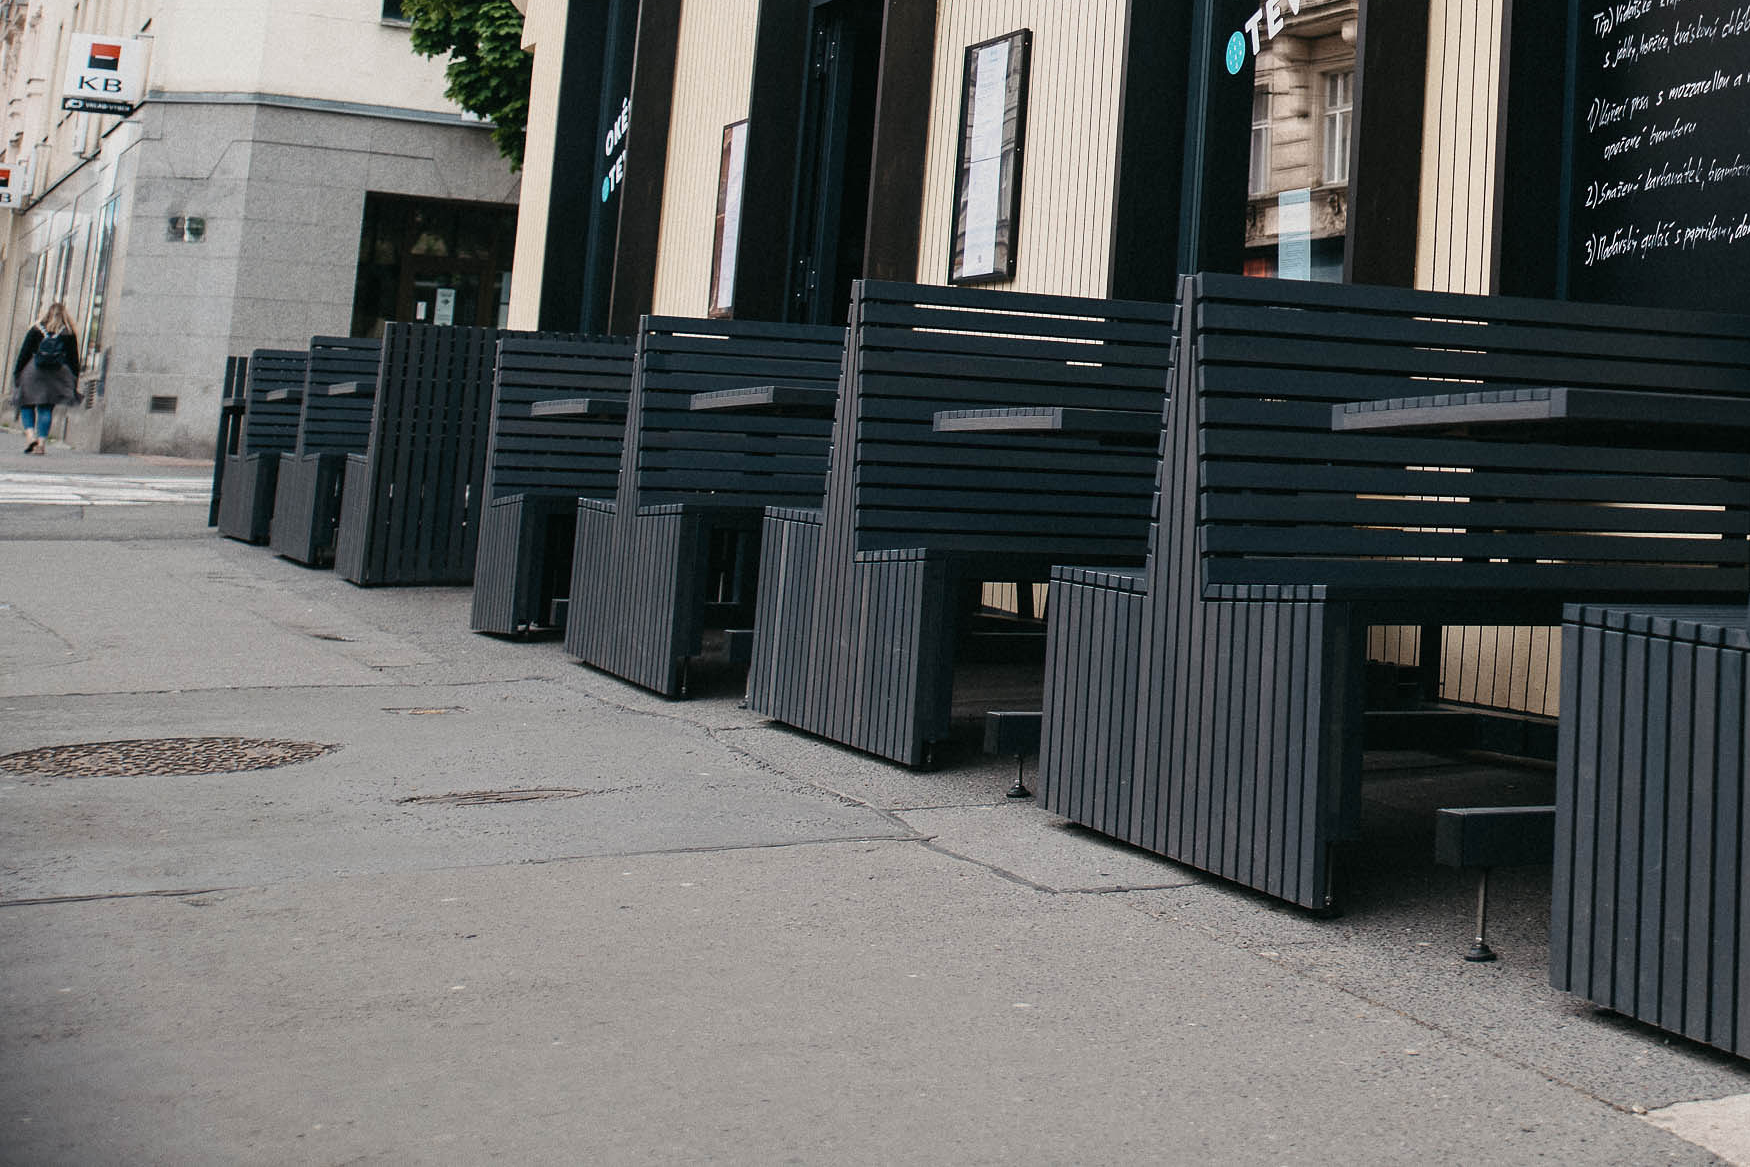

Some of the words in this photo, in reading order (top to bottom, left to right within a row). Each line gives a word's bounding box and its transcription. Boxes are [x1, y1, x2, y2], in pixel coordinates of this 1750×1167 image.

[78, 75, 122, 93] KB
[1655, 90, 1665, 106] s
[1668, 69, 1731, 101] mozzarellou
[1733, 73, 1743, 87] a
[1673, 228, 1682, 245] s
